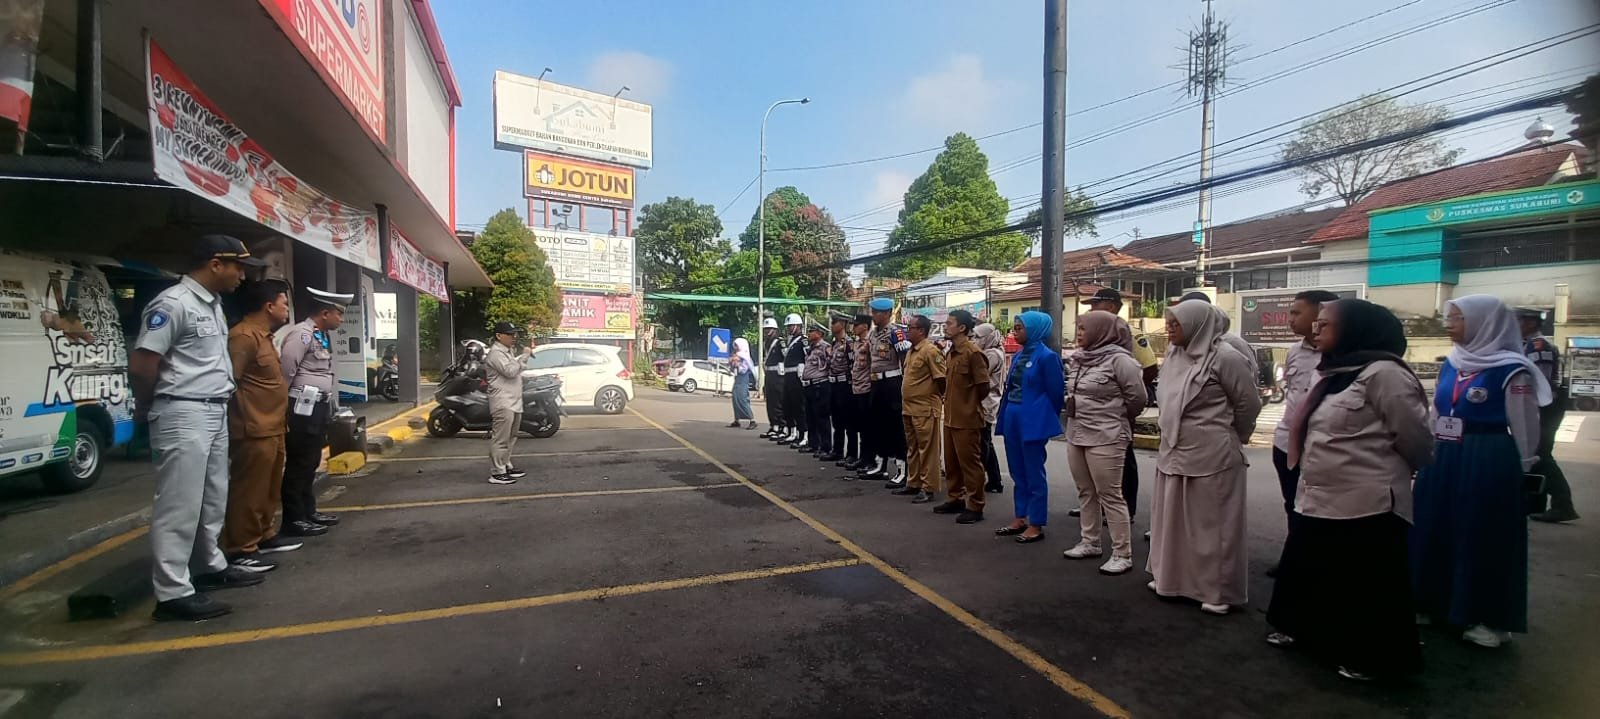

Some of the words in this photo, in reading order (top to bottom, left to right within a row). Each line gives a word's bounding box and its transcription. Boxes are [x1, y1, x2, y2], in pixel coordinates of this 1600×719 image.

[295, 0, 384, 139] SUPERMARKET
[153, 74, 163, 100] 3
[155, 125, 174, 151] MY
[558, 168, 629, 194] JOTUN
[1449, 205, 1506, 217] PUSKESMAS
[1511, 198, 1561, 210] SUKABUMI
[562, 297, 590, 307] ANIT
[562, 308, 596, 318] AMIK
[1262, 311, 1289, 324] SM
